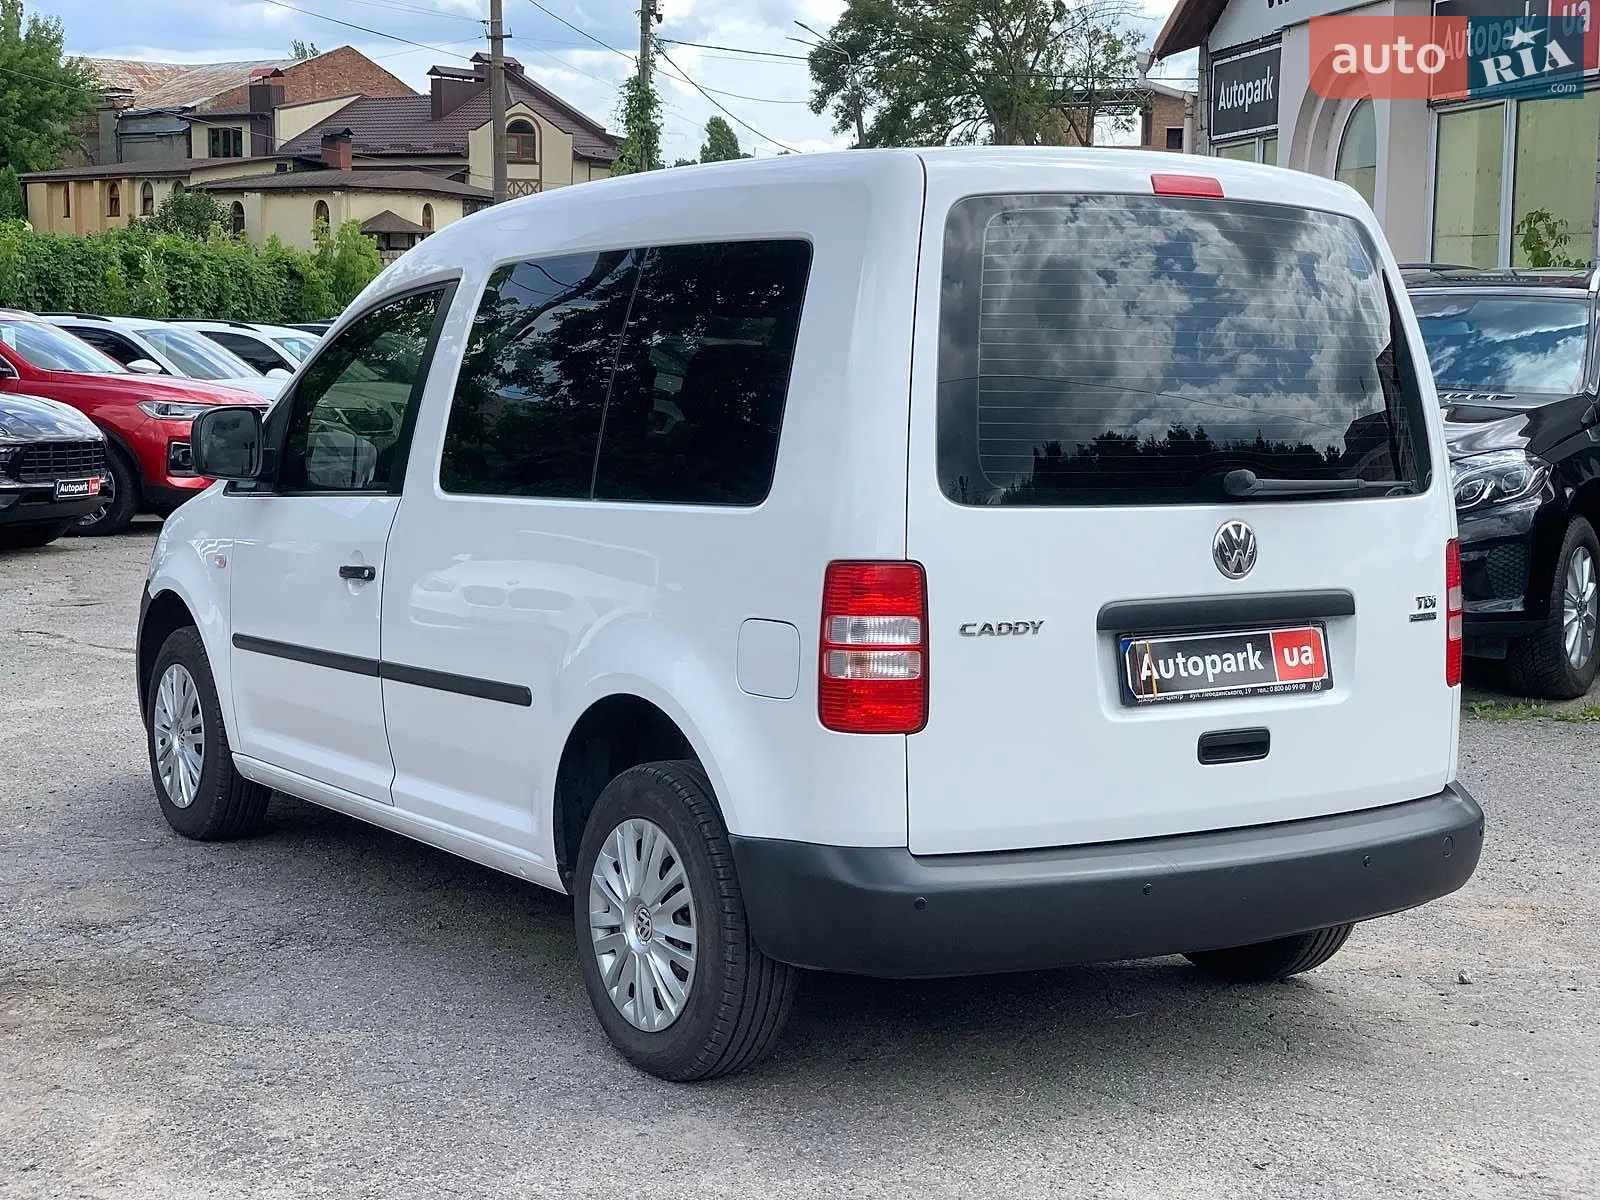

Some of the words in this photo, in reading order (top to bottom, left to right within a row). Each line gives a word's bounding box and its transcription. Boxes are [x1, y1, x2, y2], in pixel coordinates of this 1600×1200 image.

[1218, 66, 1274, 113] Autopark
[60, 482, 88, 493] Autopark
[959, 620, 1045, 637] CADDY
[1140, 643, 1265, 682] Autopark
[1283, 643, 1315, 667] ua
